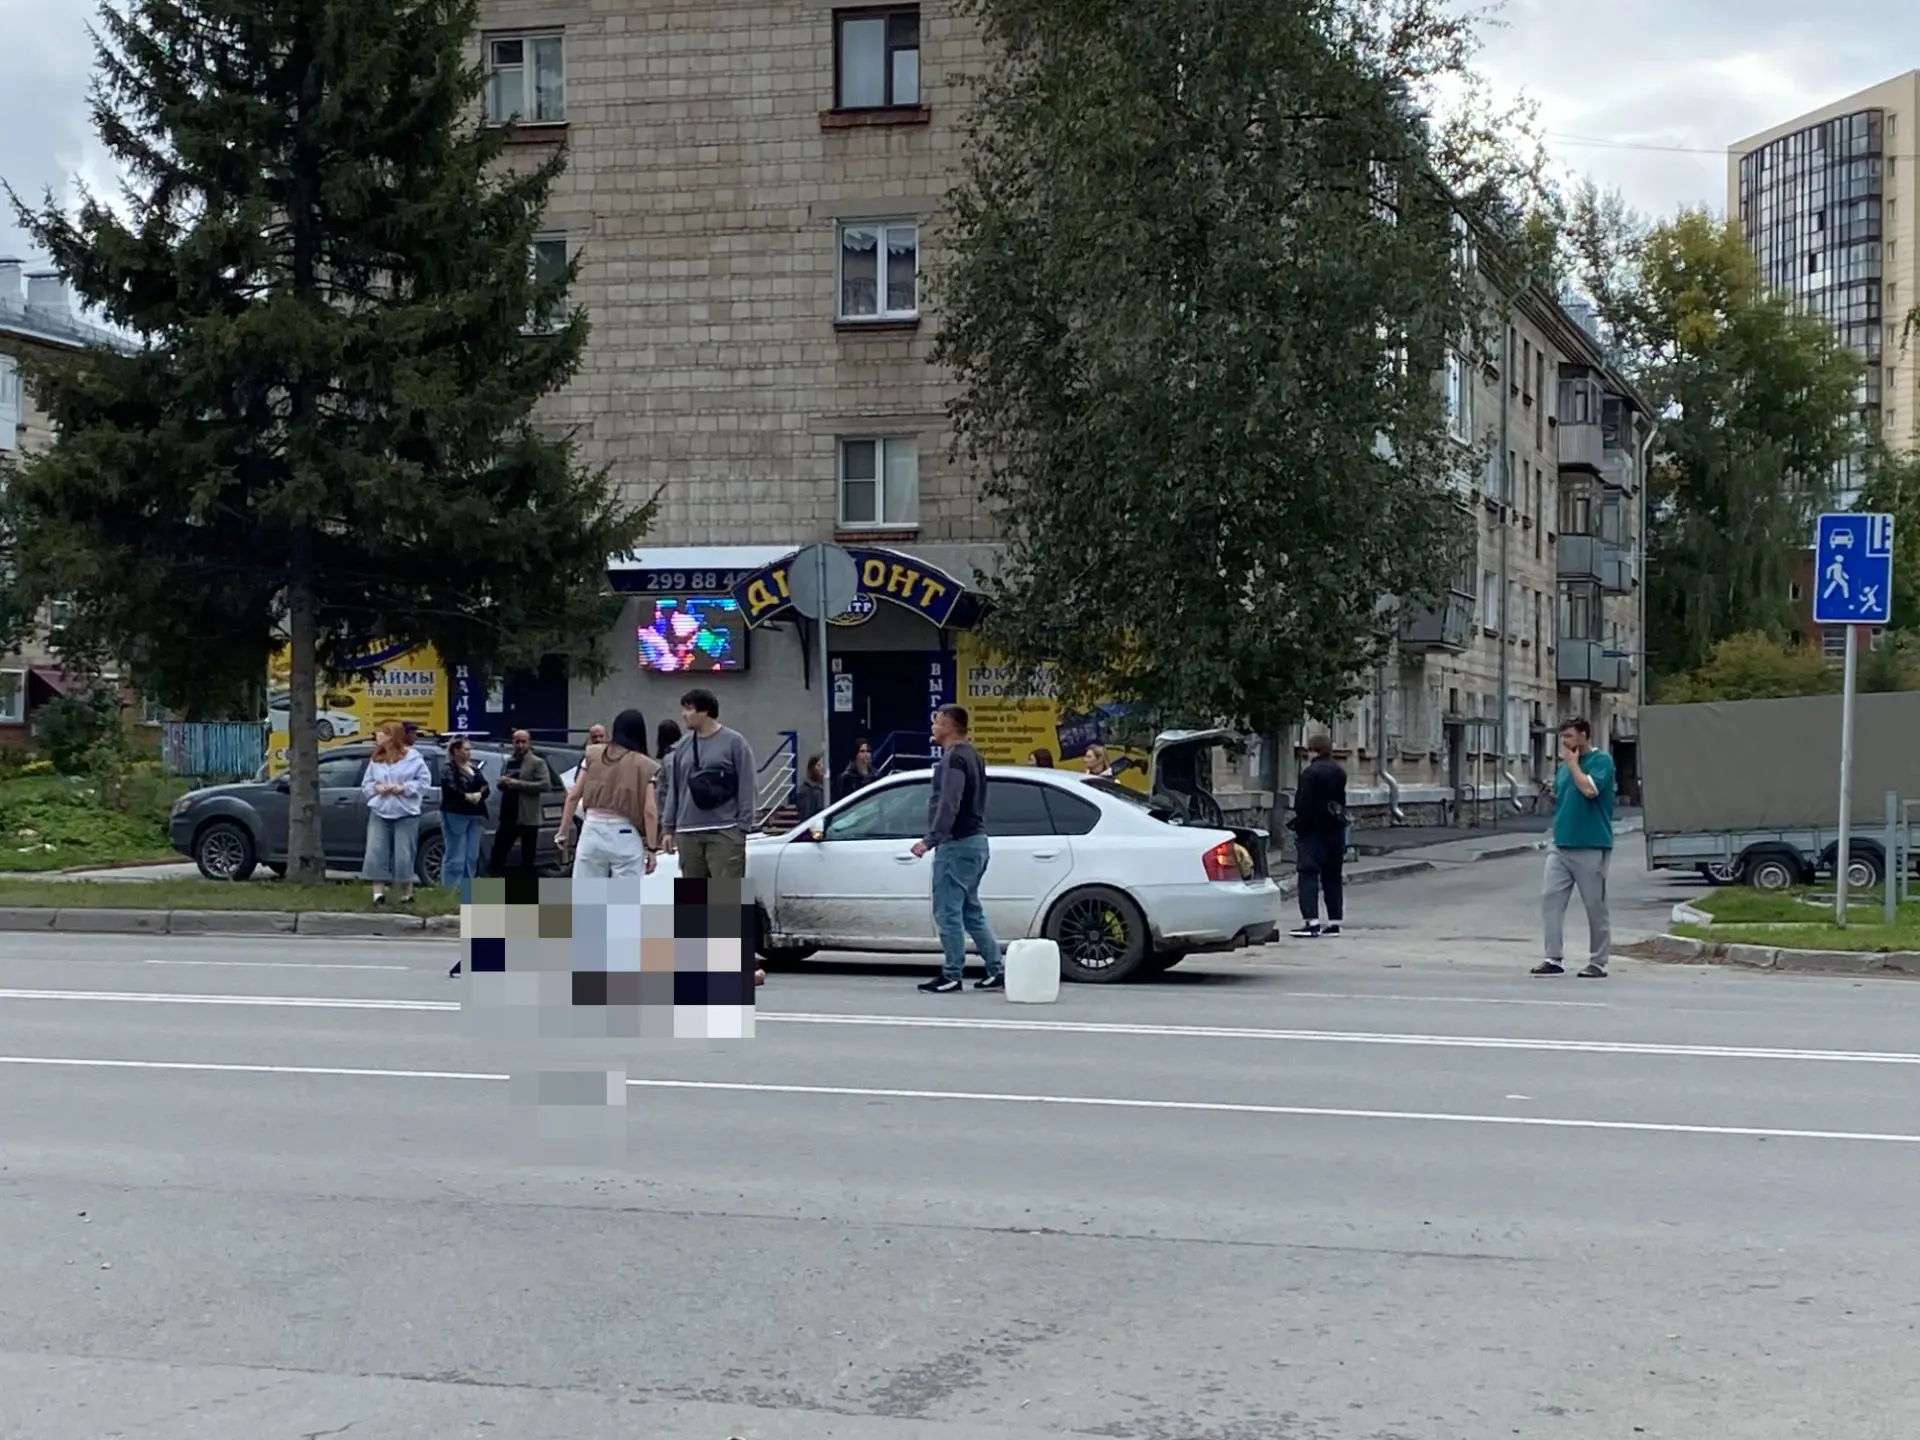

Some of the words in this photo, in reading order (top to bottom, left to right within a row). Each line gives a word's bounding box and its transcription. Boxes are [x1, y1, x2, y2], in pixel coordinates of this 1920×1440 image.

[647, 573, 686, 590] 299
[691, 573, 717, 589] 88
[747, 559, 946, 617] ДОНТ
[369, 669, 434, 684] АЙМЫ
[968, 667, 1057, 681] ПОКУКА
[968, 684, 1058, 697] ПРОДЖА
